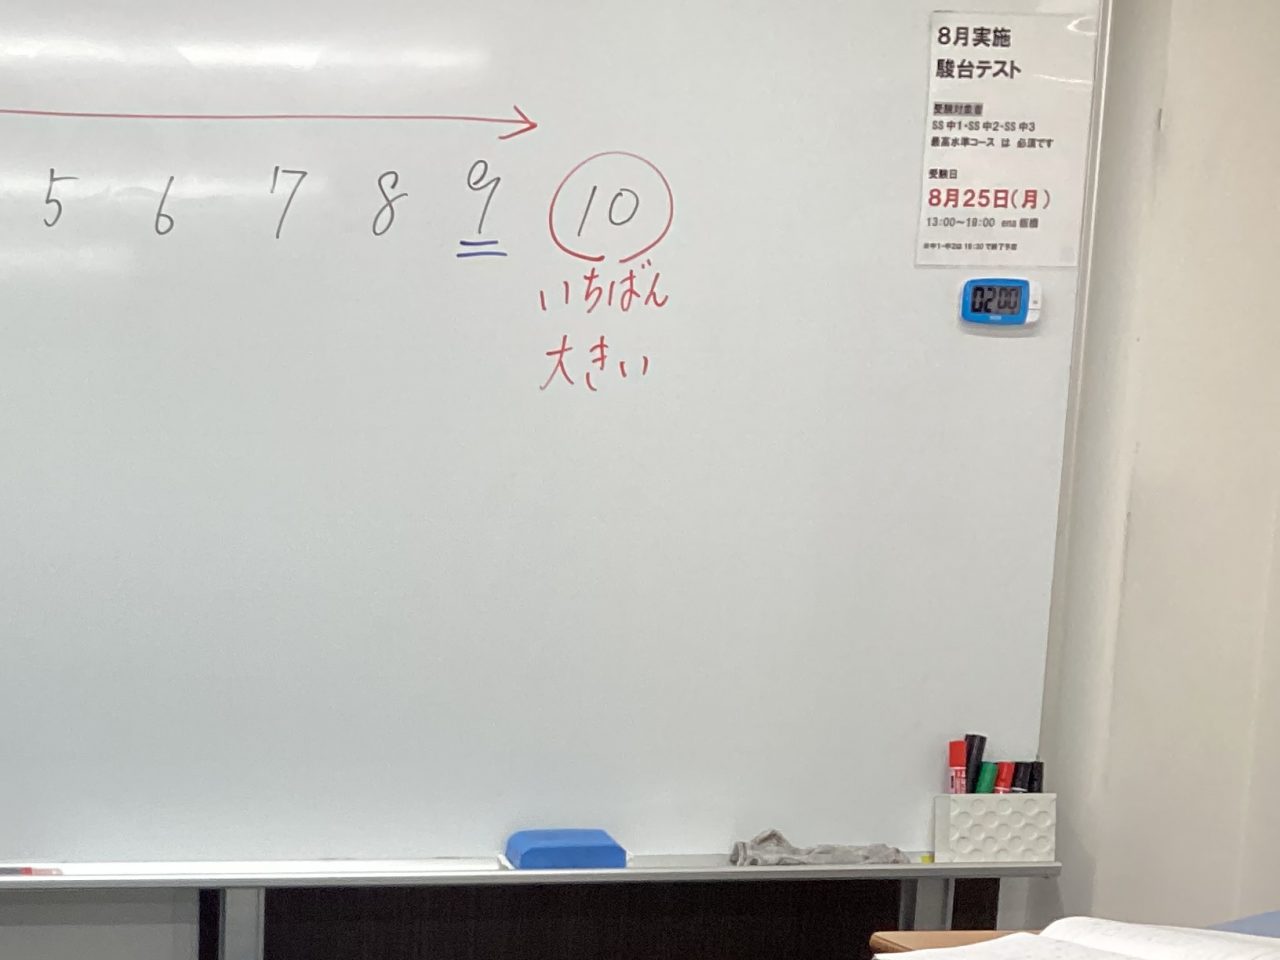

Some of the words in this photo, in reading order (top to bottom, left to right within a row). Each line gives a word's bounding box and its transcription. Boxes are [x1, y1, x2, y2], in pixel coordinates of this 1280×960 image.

[937, 26, 1012, 48] 8月実施
[935, 58, 1022, 80] 駿台テスト
[928, 168, 958, 180] 受験日
[43, 168, 79, 227] 5
[155, 176, 174, 235] 6
[270, 165, 307, 238] 7
[372, 171, 408, 235] 8
[467, 159, 500, 234] 9
[578, 185, 639, 236] 10
[538, 258, 668, 313] いちばん
[539, 334, 650, 391] 大きい
